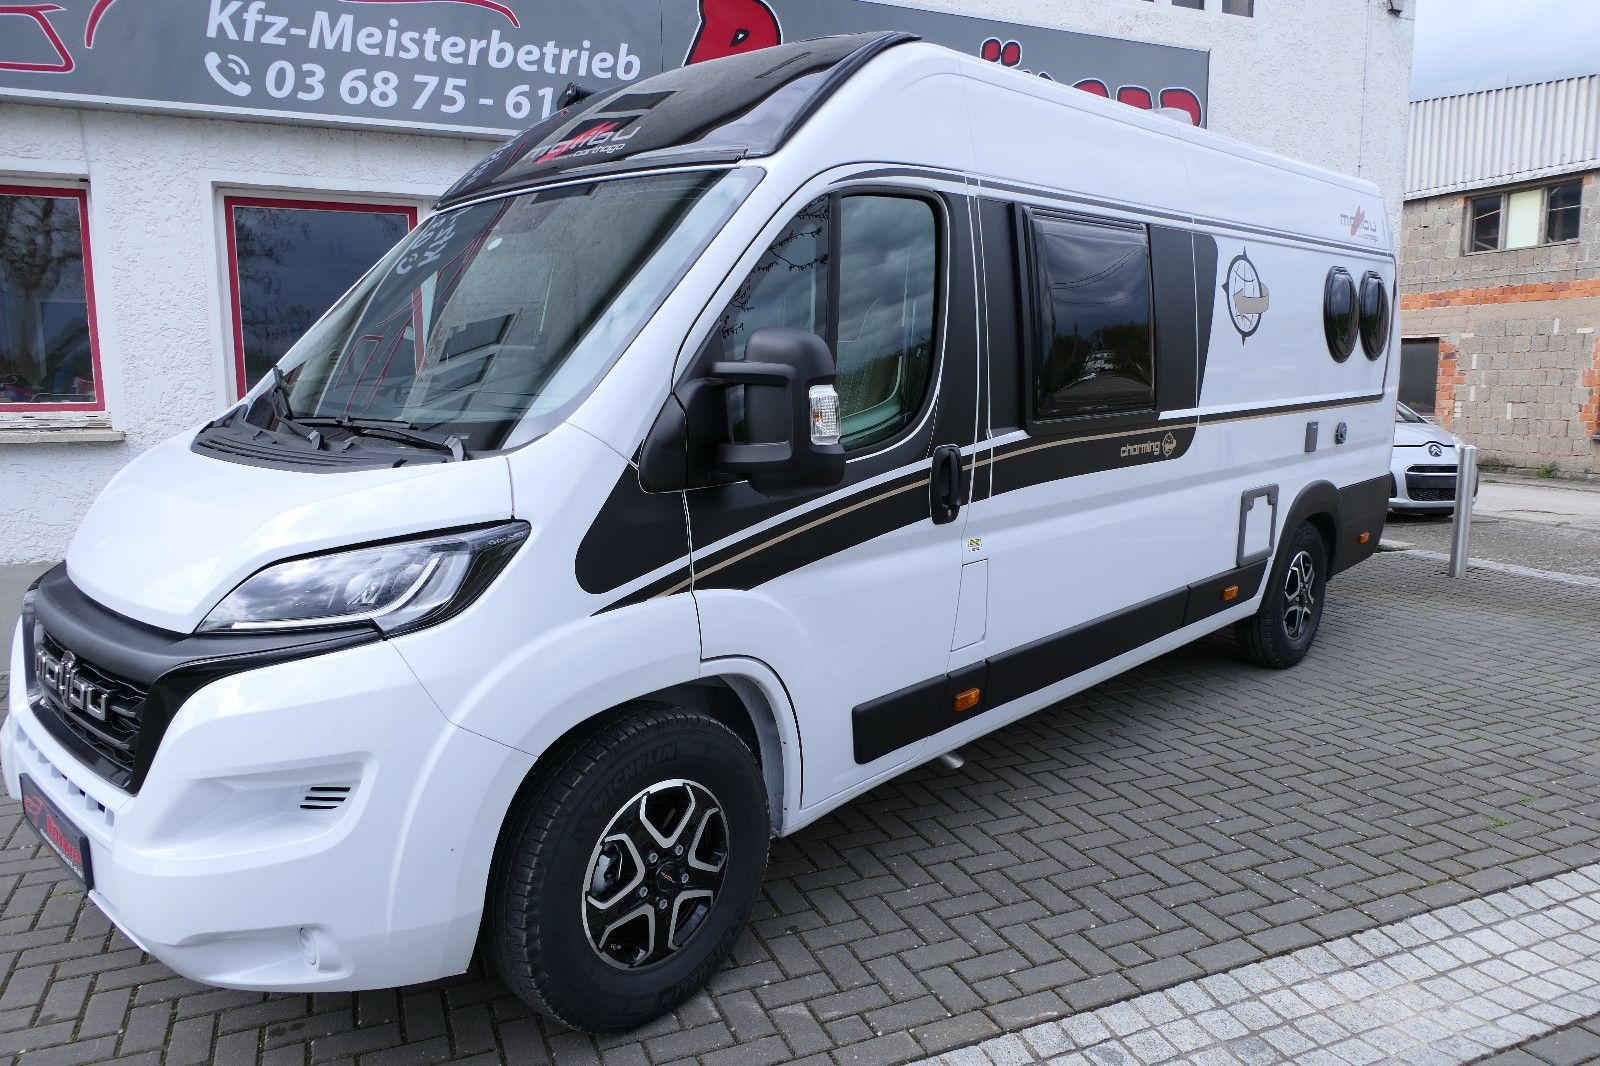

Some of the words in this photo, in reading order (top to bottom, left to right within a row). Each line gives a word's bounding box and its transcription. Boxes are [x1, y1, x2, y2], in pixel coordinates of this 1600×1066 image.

[207, 0, 641, 81] Kfz-Meisterbetrieb
[265, 61, 326, 101] 03
[340, 69, 399, 108] 68
[411, 75, 467, 114] 75
[1120, 441, 1161, 457] charming
